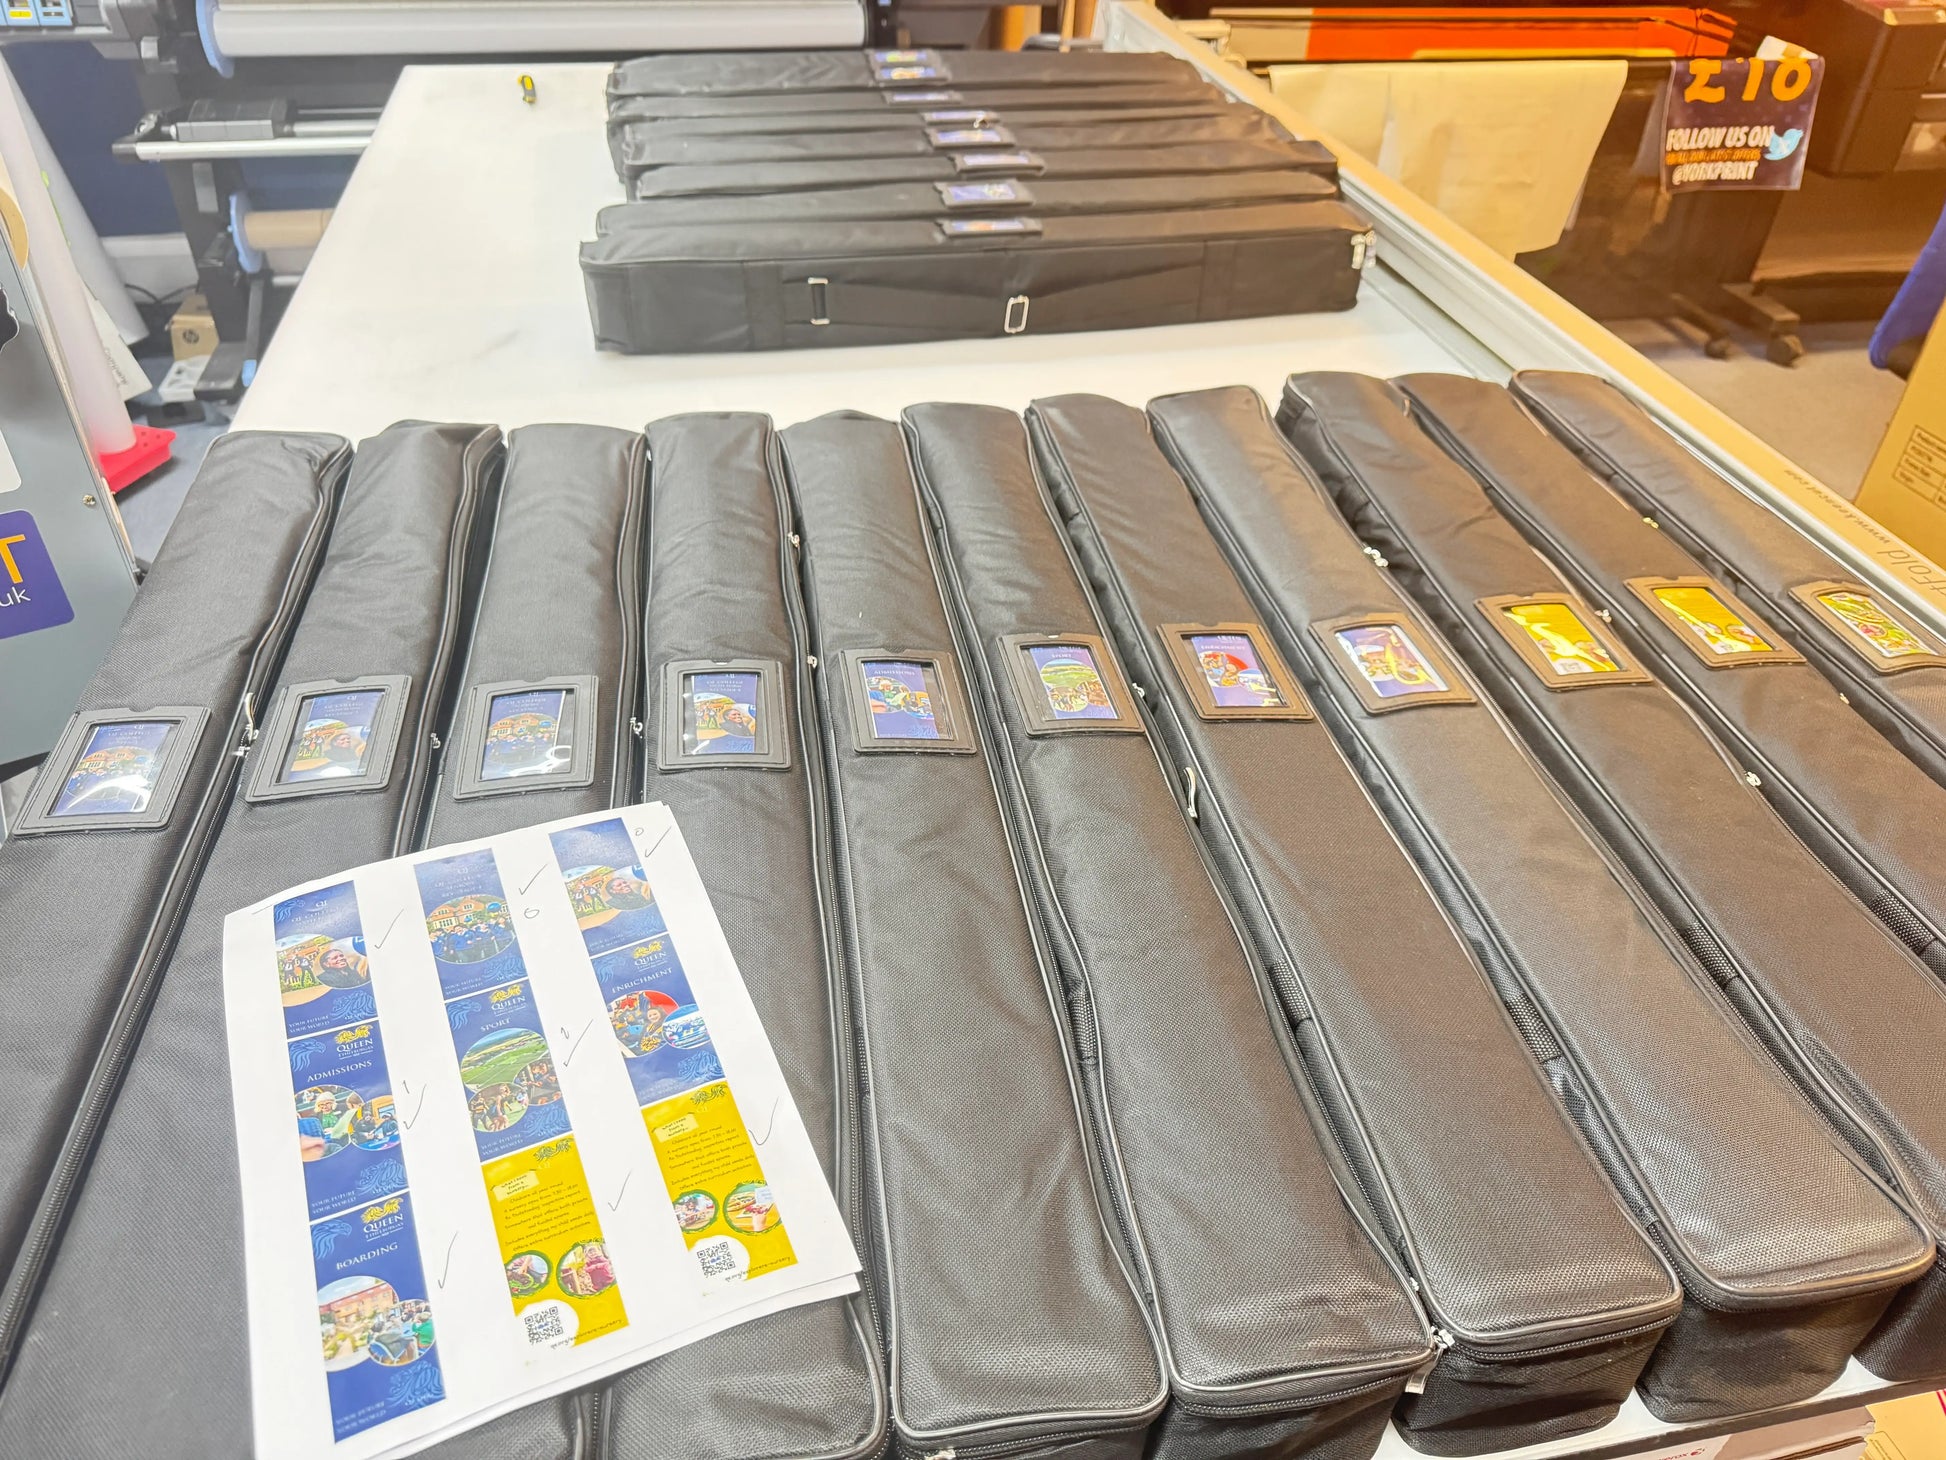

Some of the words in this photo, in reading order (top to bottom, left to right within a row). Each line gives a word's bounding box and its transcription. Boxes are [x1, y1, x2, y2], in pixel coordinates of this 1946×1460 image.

[1666, 127, 1727, 151] FOLLOW
[1725, 126, 1749, 148] US
[1747, 125, 1775, 148] ON
[634, 952, 667, 966] QUEEN
[612, 967, 673, 994] ENRICHMENT
[491, 995, 526, 1011] QUEEN
[480, 1018, 511, 1032] SPORT
[336, 1038, 373, 1053] QUEEN
[307, 1060, 373, 1082] ADMISSIONS
[363, 1213, 404, 1233] QUEEN
[336, 1242, 398, 1270] BOARDING
